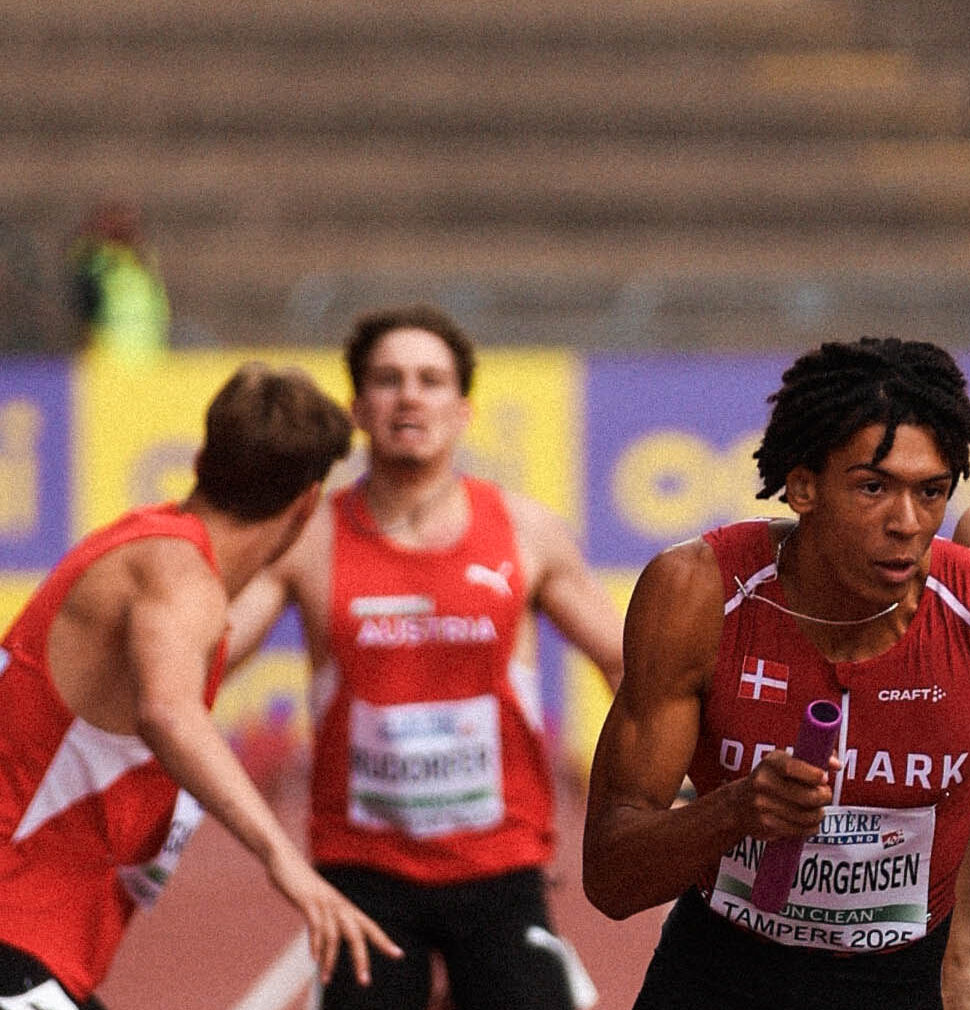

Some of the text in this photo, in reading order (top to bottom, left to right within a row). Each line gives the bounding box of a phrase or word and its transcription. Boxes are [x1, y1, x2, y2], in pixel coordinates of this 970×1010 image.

[878, 688, 931, 702] CRAFT
[809, 908, 874, 923] CLEAN
[723, 901, 913, 949] TAMPERE 2025
